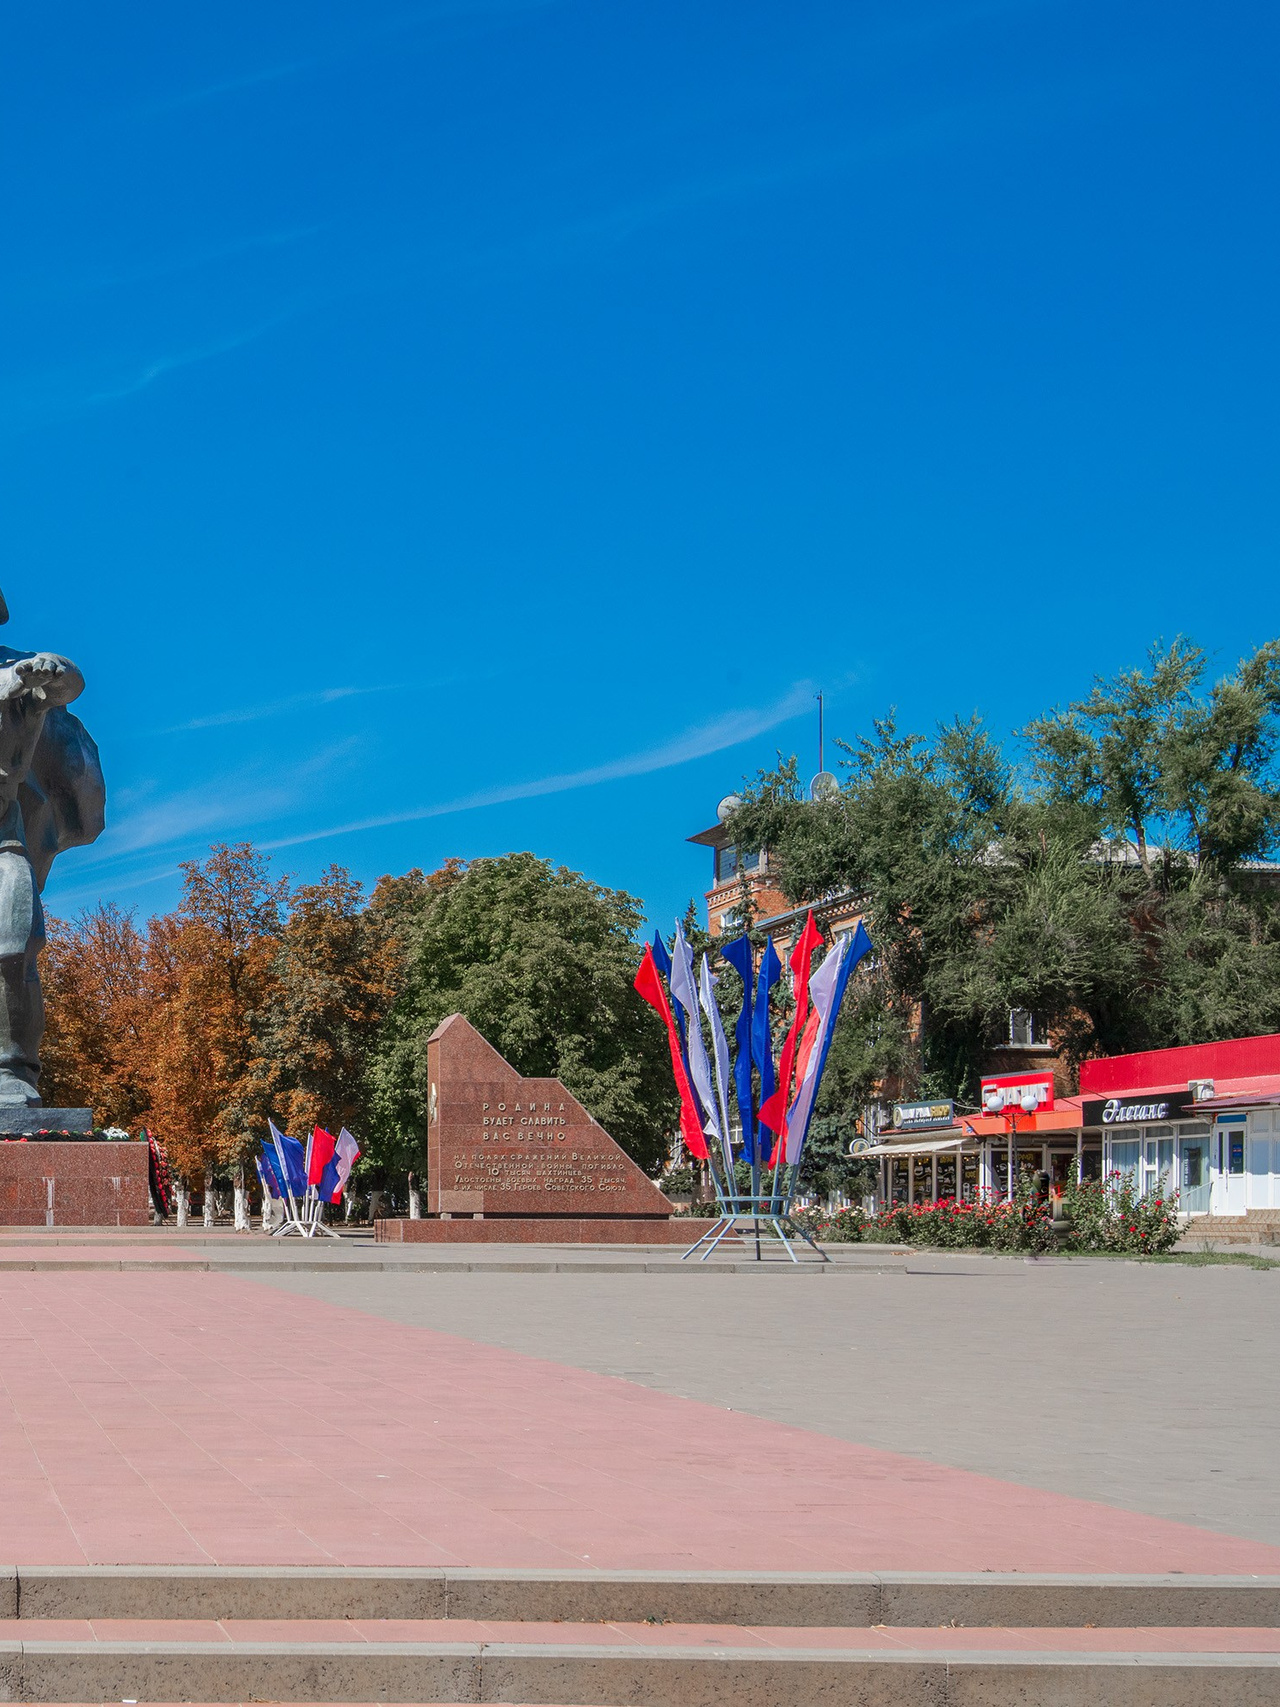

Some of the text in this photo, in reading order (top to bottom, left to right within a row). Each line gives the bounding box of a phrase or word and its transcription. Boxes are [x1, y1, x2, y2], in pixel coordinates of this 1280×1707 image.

[483, 1103, 565, 1111] РОДИНА
[483, 1117, 566, 1126] БУДЕТ СЛАВИТЬ
[483, 1131, 565, 1140] ВАС ВЕЧНО
[488, 1168, 499, 1176] 10
